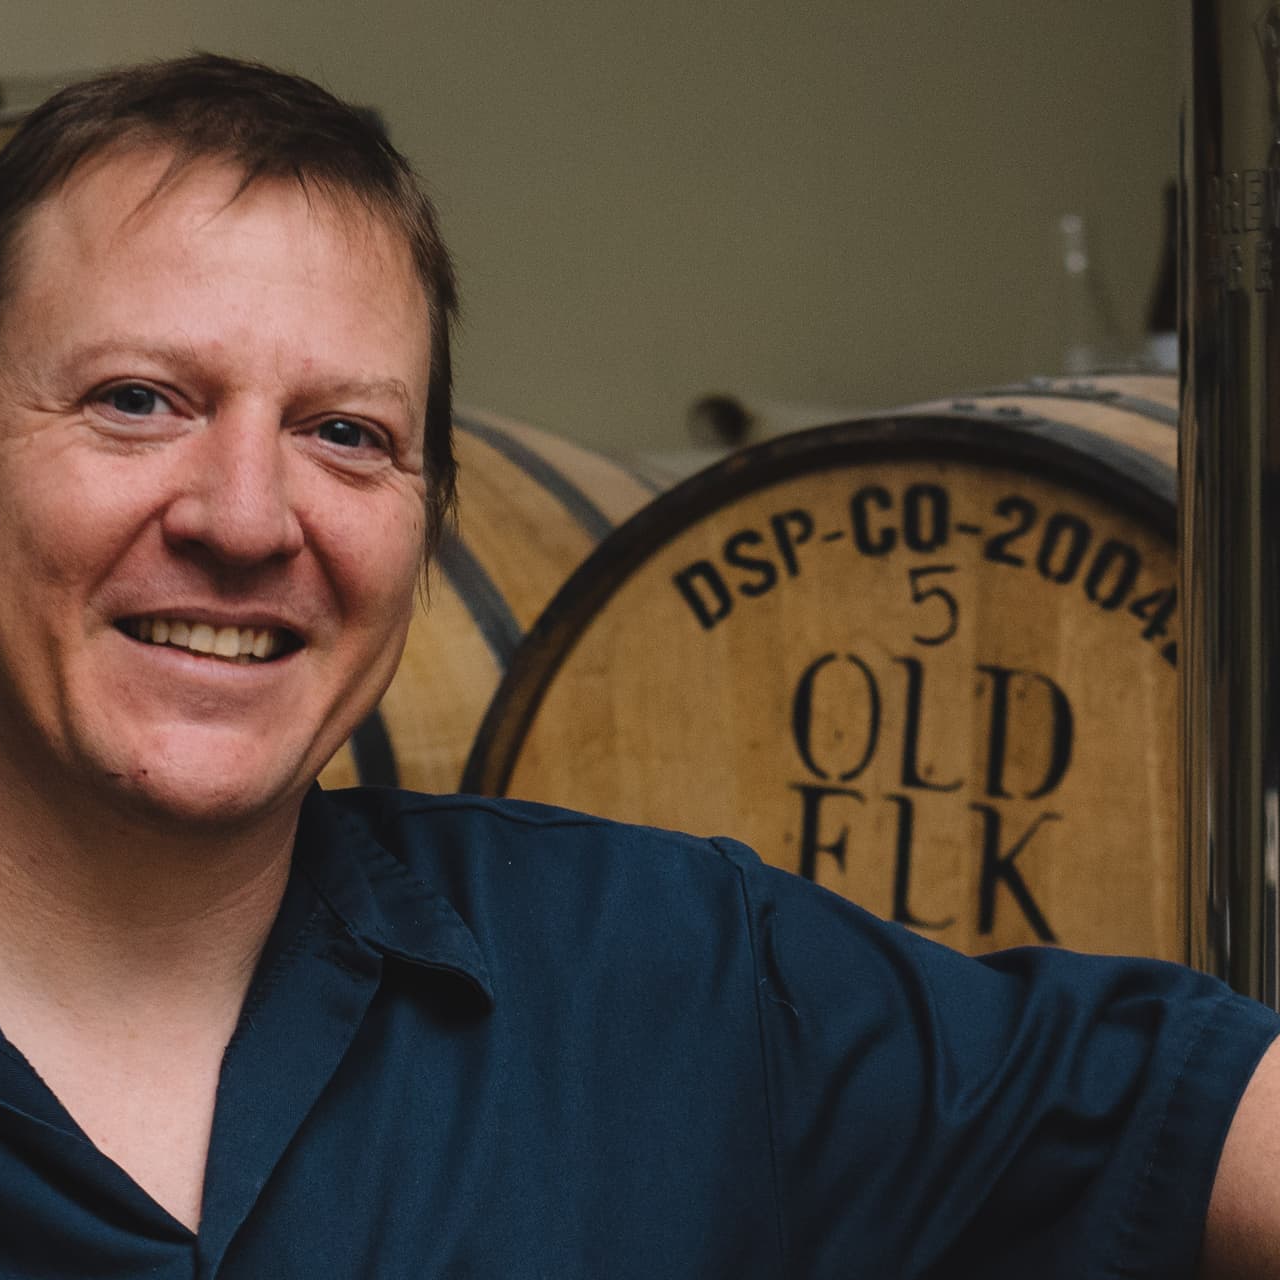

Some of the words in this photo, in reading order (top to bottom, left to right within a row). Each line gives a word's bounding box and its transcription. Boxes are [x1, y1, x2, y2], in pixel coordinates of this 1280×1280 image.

[673, 483, 1177, 670] DSP-CO-2004
[907, 564, 959, 647] 5
[791, 650, 1075, 801] OLD
